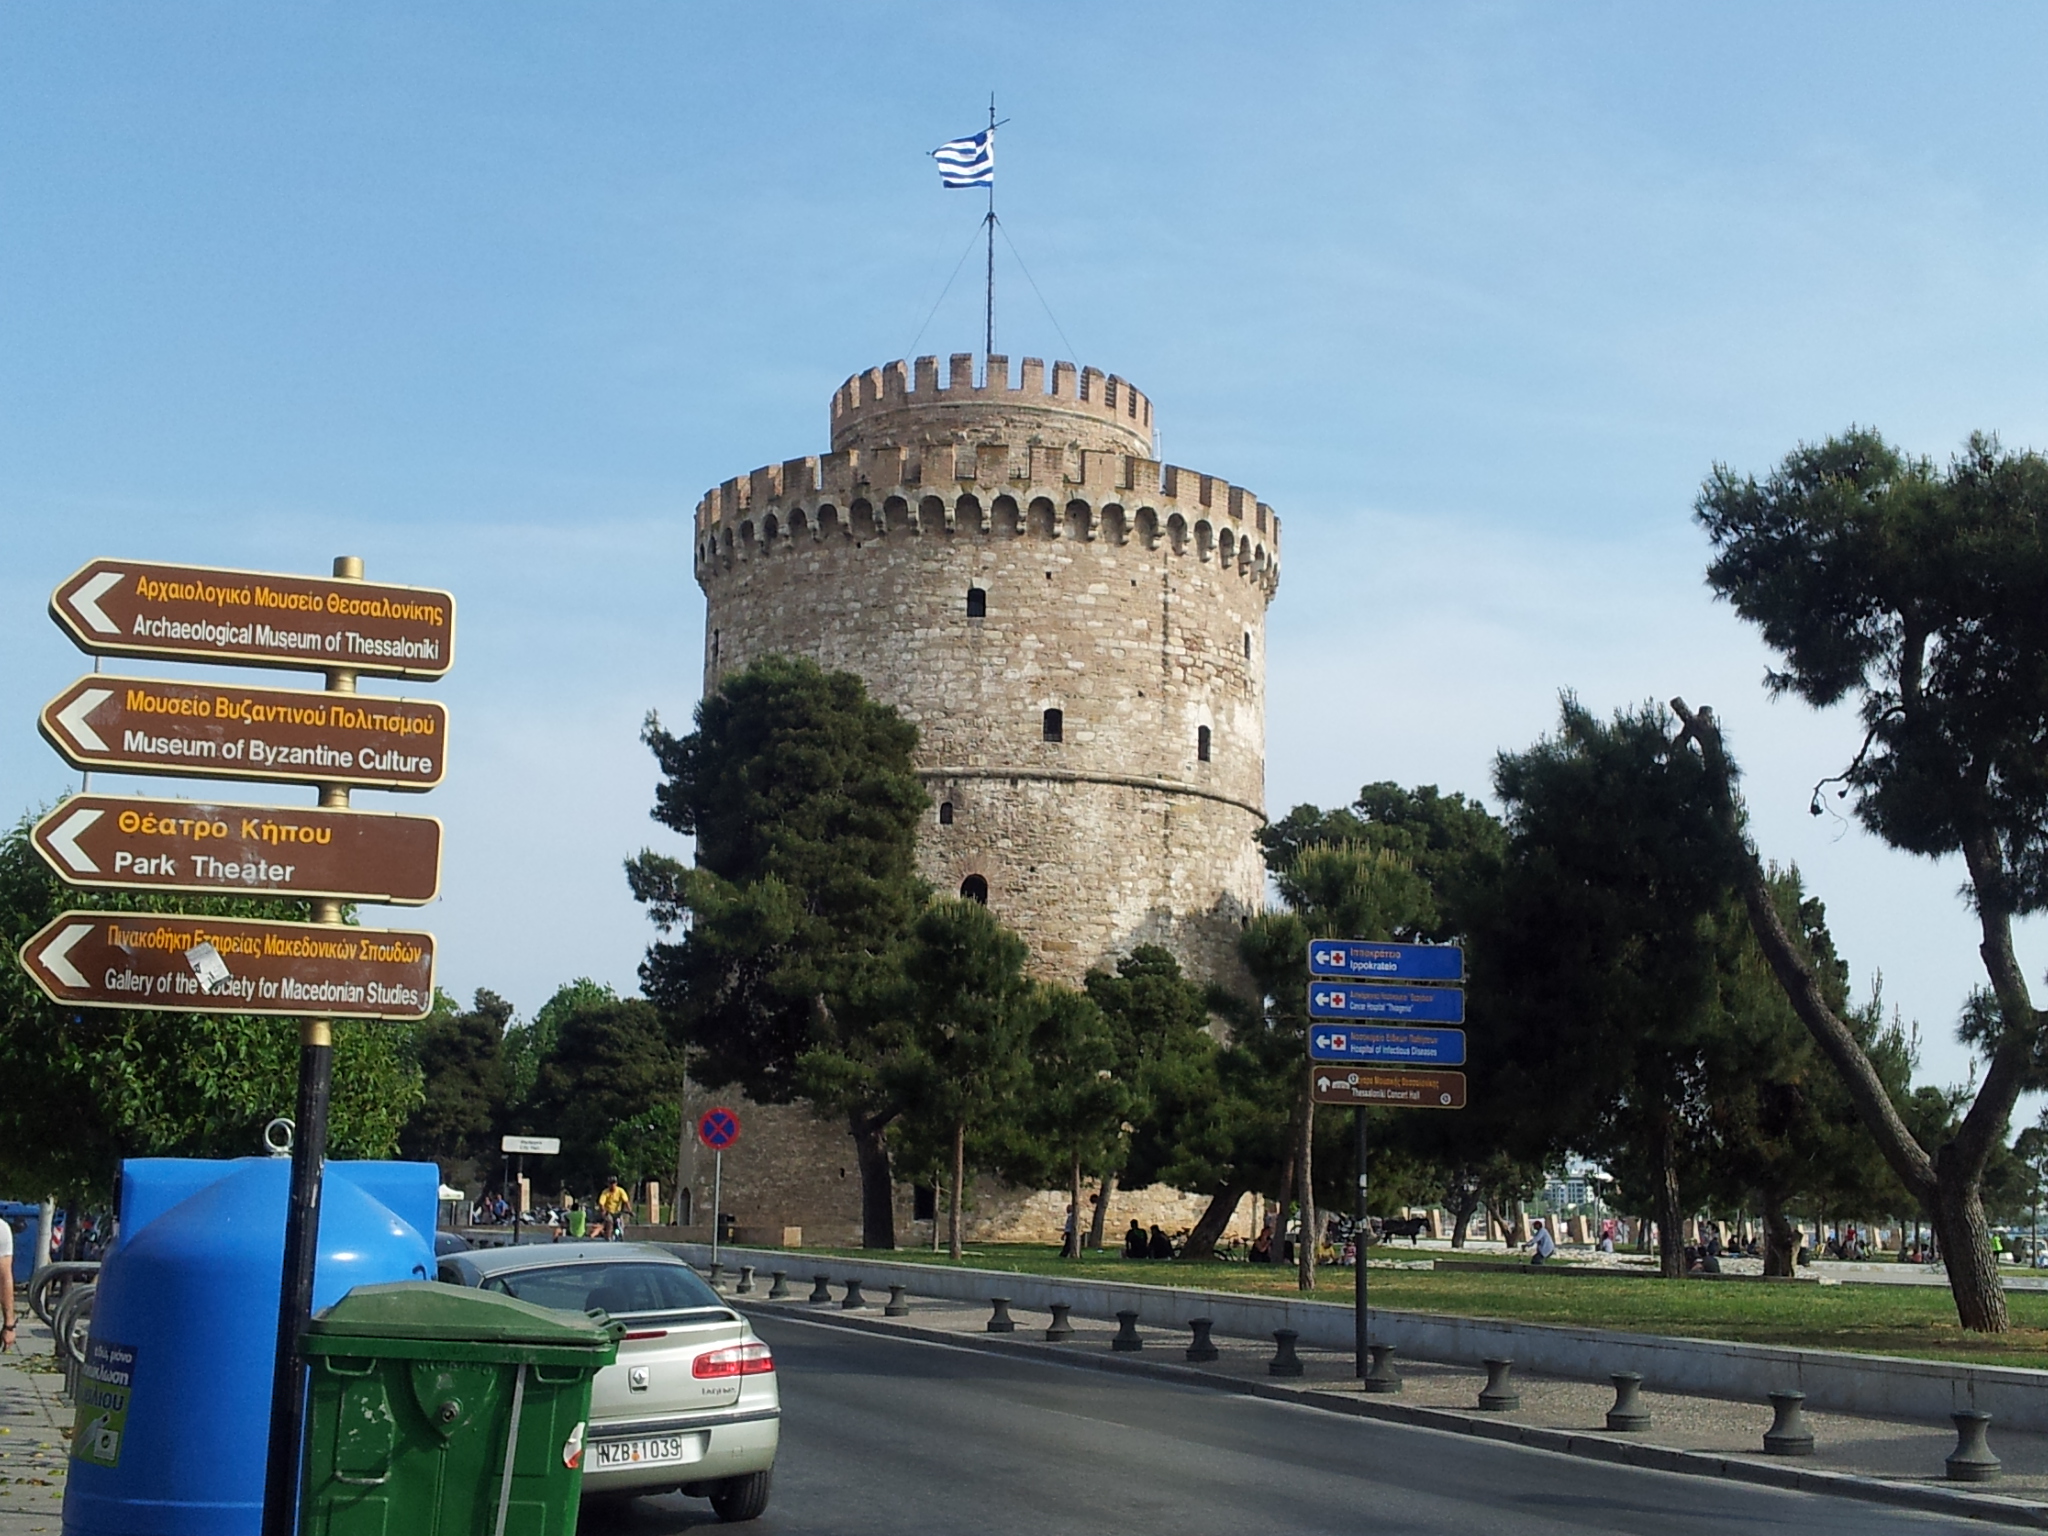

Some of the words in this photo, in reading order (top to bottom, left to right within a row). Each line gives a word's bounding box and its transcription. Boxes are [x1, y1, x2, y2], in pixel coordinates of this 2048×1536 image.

[136, 574, 251, 608] Αρχαιολογικό
[254, 585, 324, 612] Μουσείο
[326, 592, 444, 627] Θεσσαλονίκης
[132, 613, 252, 648] Archaeological
[255, 623, 322, 650] Museum
[325, 632, 342, 652] of
[345, 631, 441, 661] Thessaloniki
[126, 689, 211, 718] Μουσείο
[214, 696, 327, 727] Βυζαντινού
[329, 706, 436, 737] Πολιτισμού
[123, 729, 217, 758] Museum
[221, 738, 244, 760] of
[249, 739, 354, 768] Byzantine
[357, 747, 434, 774] Culture
[118, 810, 229, 842] Θέατρο
[241, 817, 332, 846] Κήπου
[114, 851, 176, 877] Park
[190, 855, 296, 883] Theater
[107, 925, 192, 954] Πινακοθήκη
[263, 934, 357, 960] Μακεδονικών
[358, 941, 422, 963] Σπουδών
[104, 967, 154, 996] Gallery
[156, 970, 174, 994] of
[175, 971, 198, 996] the
[202, 974, 255, 1002] ociety
[258, 975, 277, 999] for
[281, 977, 365, 1004] Macedonian
[366, 984, 418, 1007] Studies
[601, 1443, 630, 1464] NZB
[643, 1438, 679, 1460] 1039
